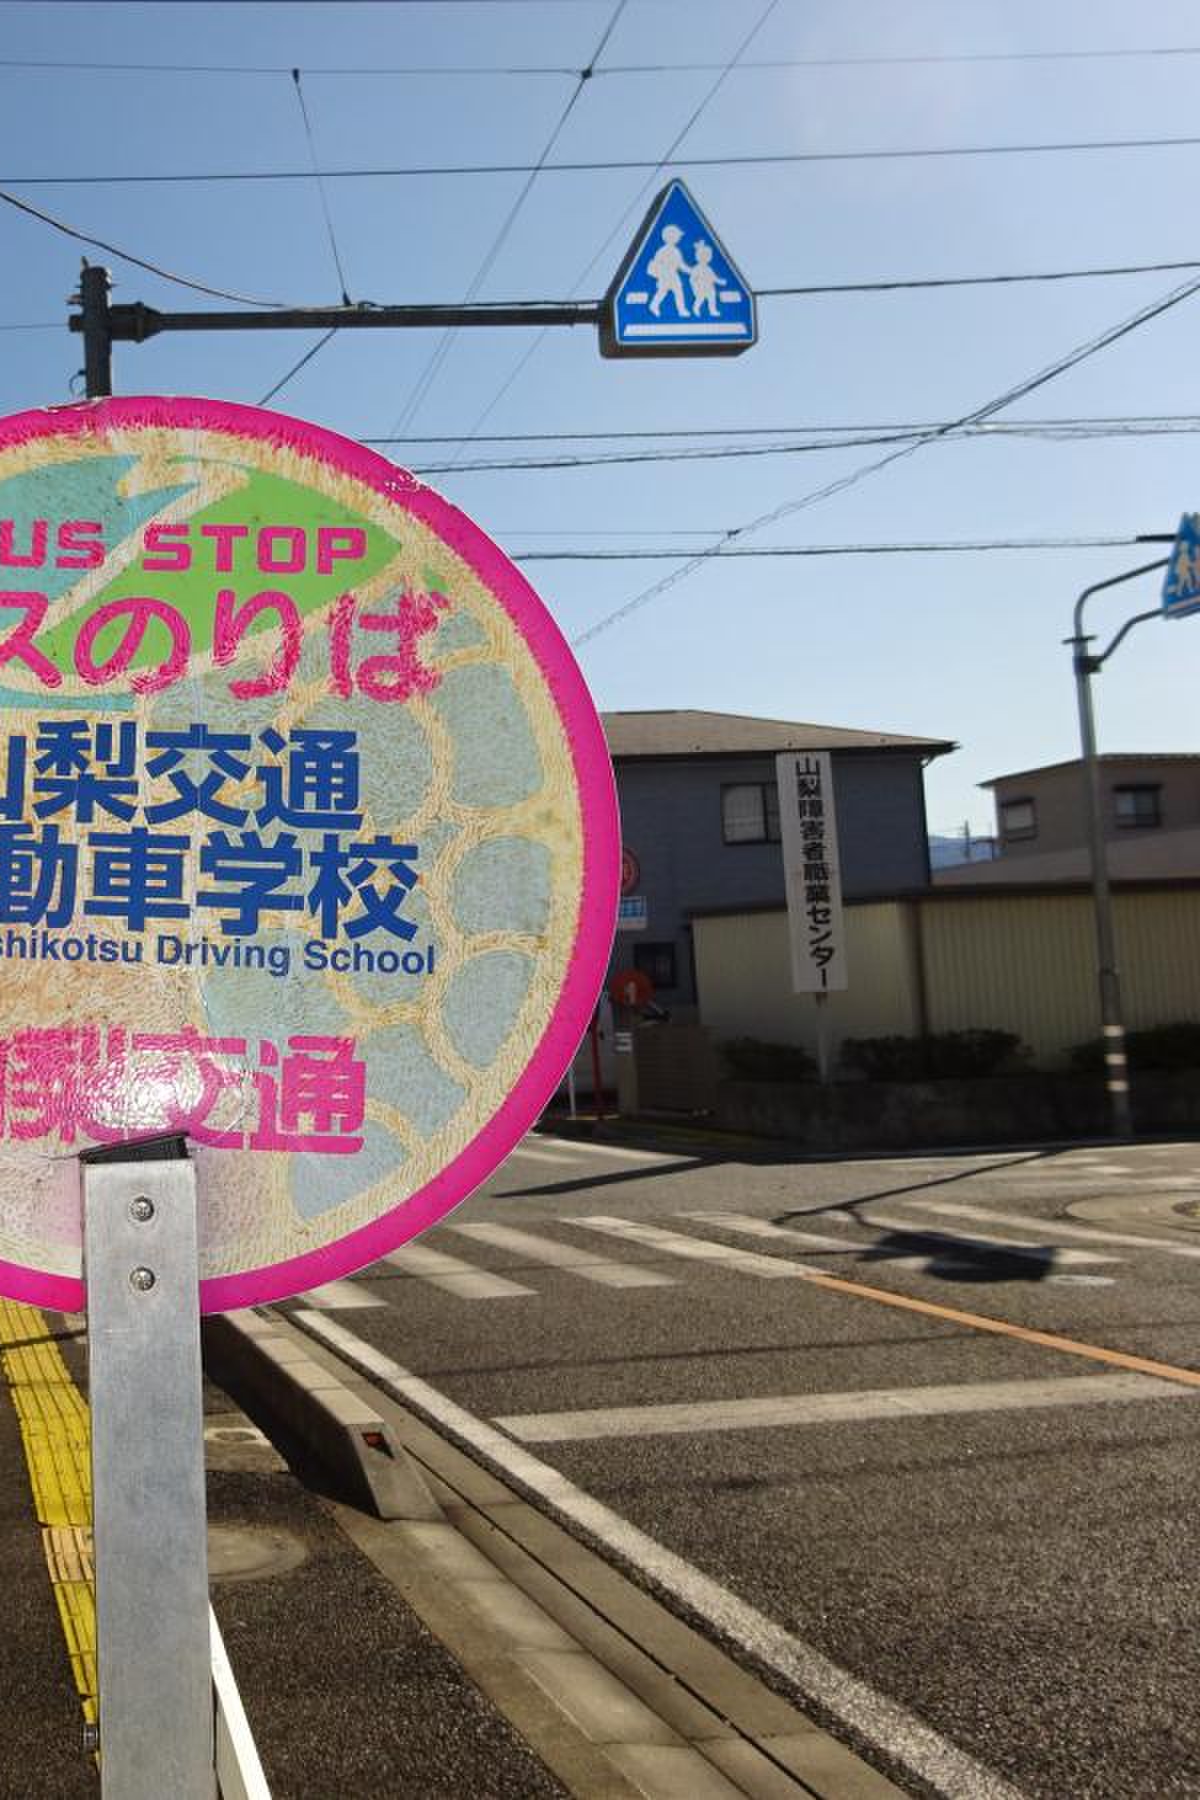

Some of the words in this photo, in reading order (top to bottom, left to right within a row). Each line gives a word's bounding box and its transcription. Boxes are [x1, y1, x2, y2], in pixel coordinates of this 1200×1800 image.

[142, 524, 367, 575] STOP
[156, 935, 291, 977] Driving
[303, 941, 436, 976] School
